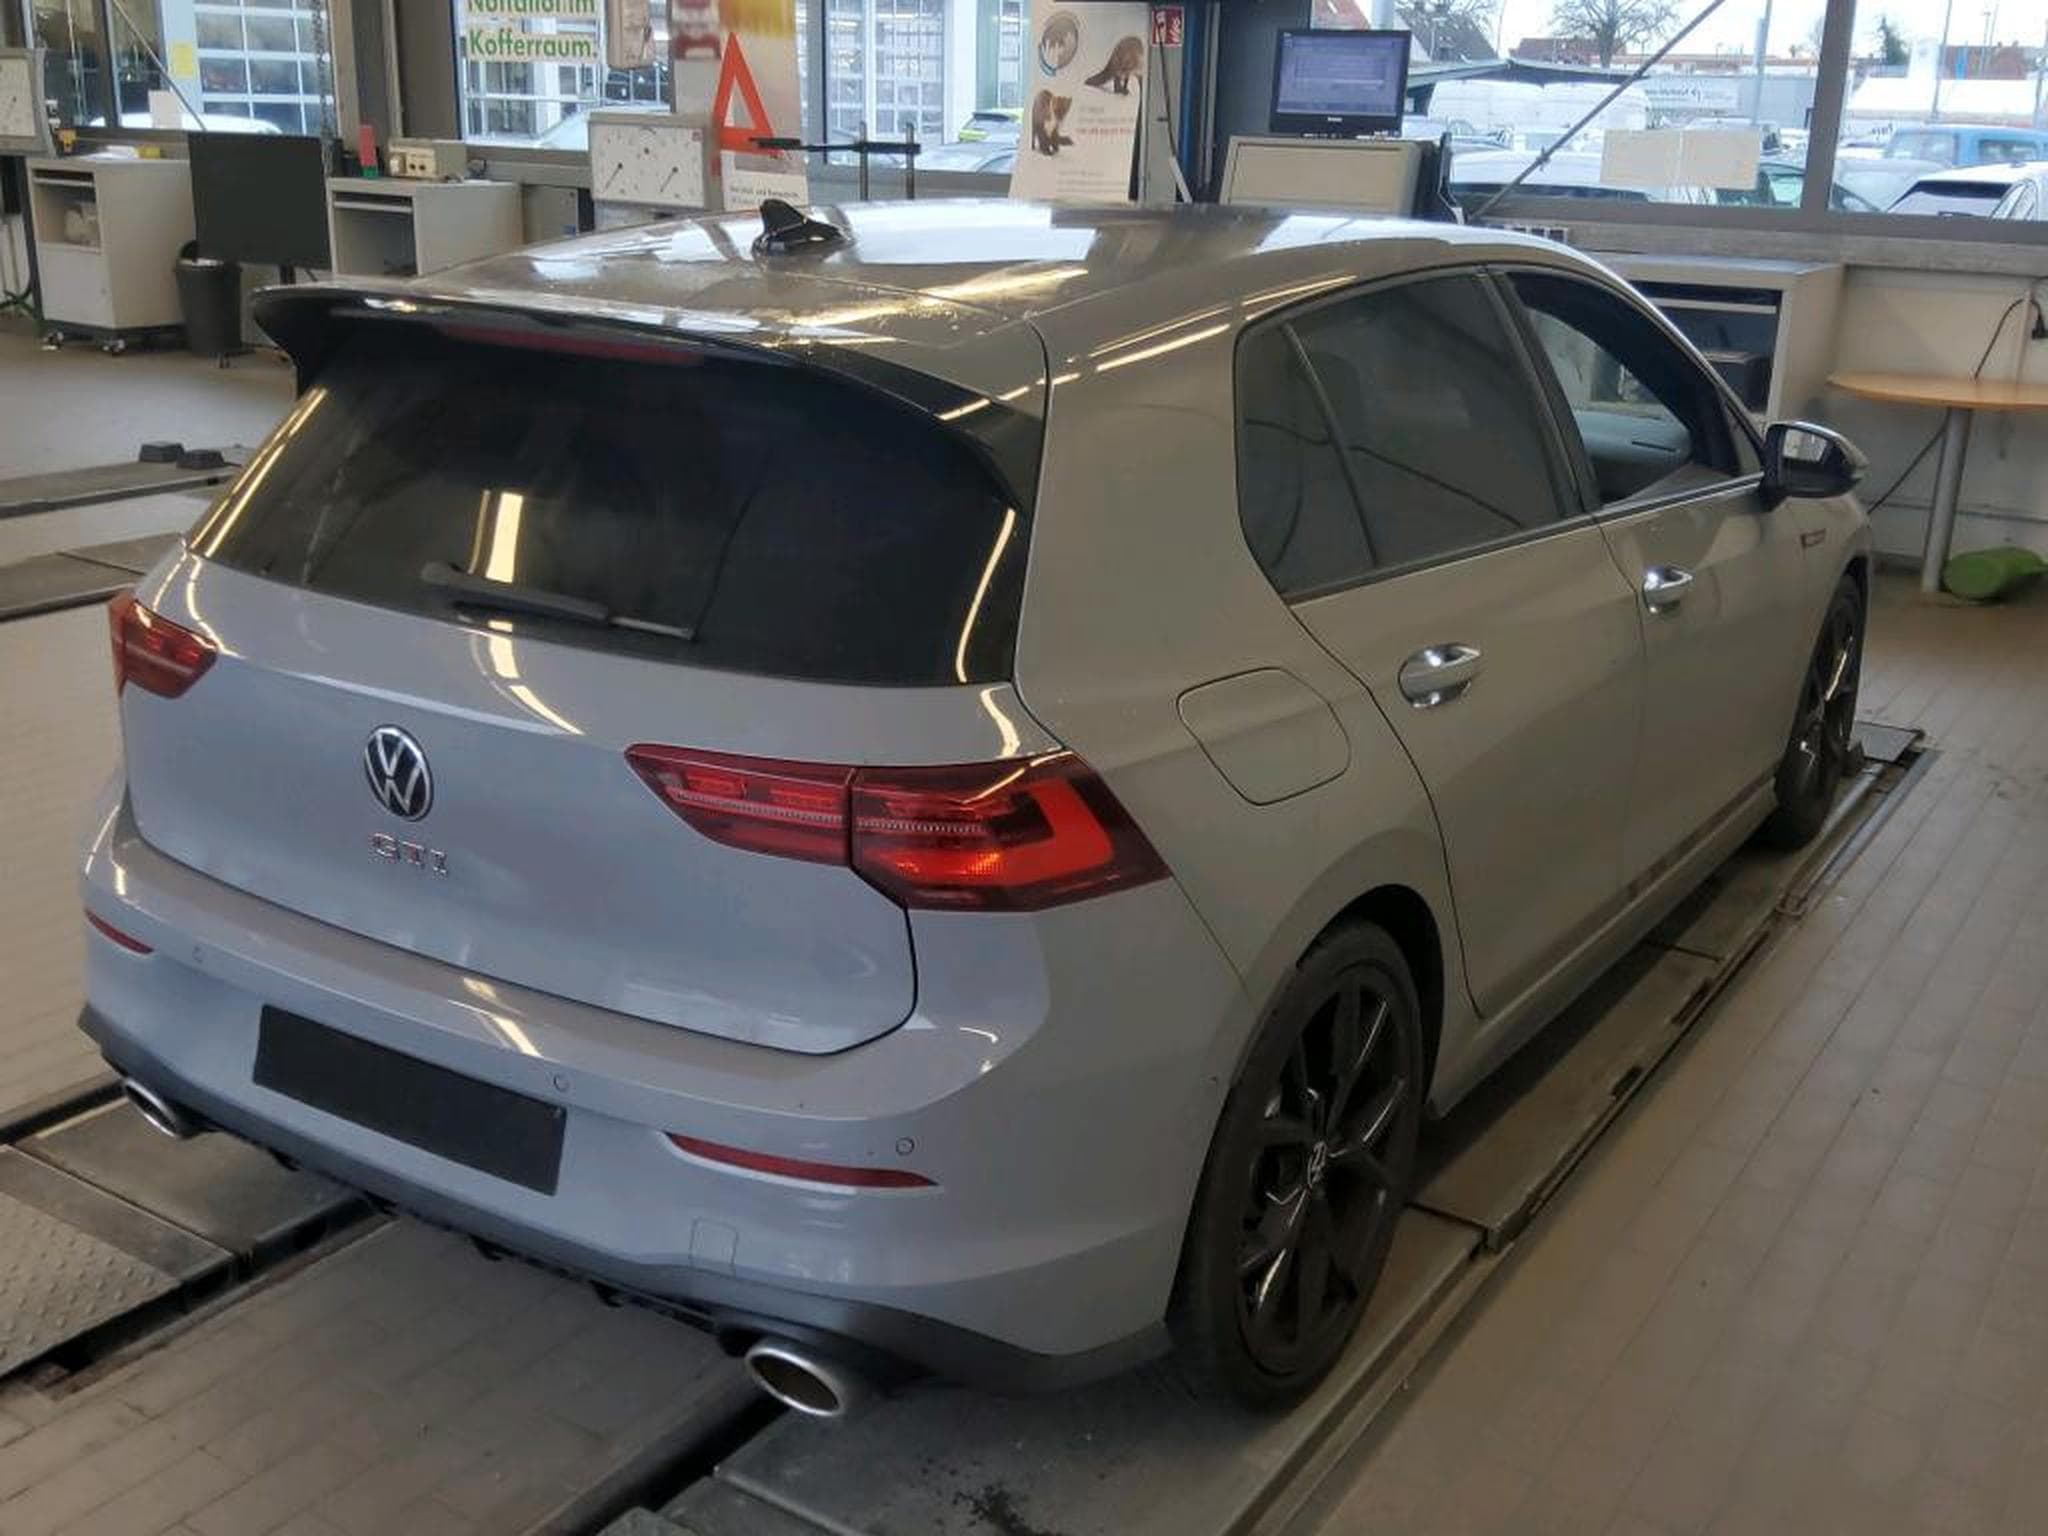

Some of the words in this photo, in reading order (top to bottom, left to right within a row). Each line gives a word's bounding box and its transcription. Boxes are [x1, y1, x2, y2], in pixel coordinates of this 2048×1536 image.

[469, 28, 598, 58] Kofferraum.
[364, 724, 434, 822] VW
[373, 832, 447, 874] GTI
